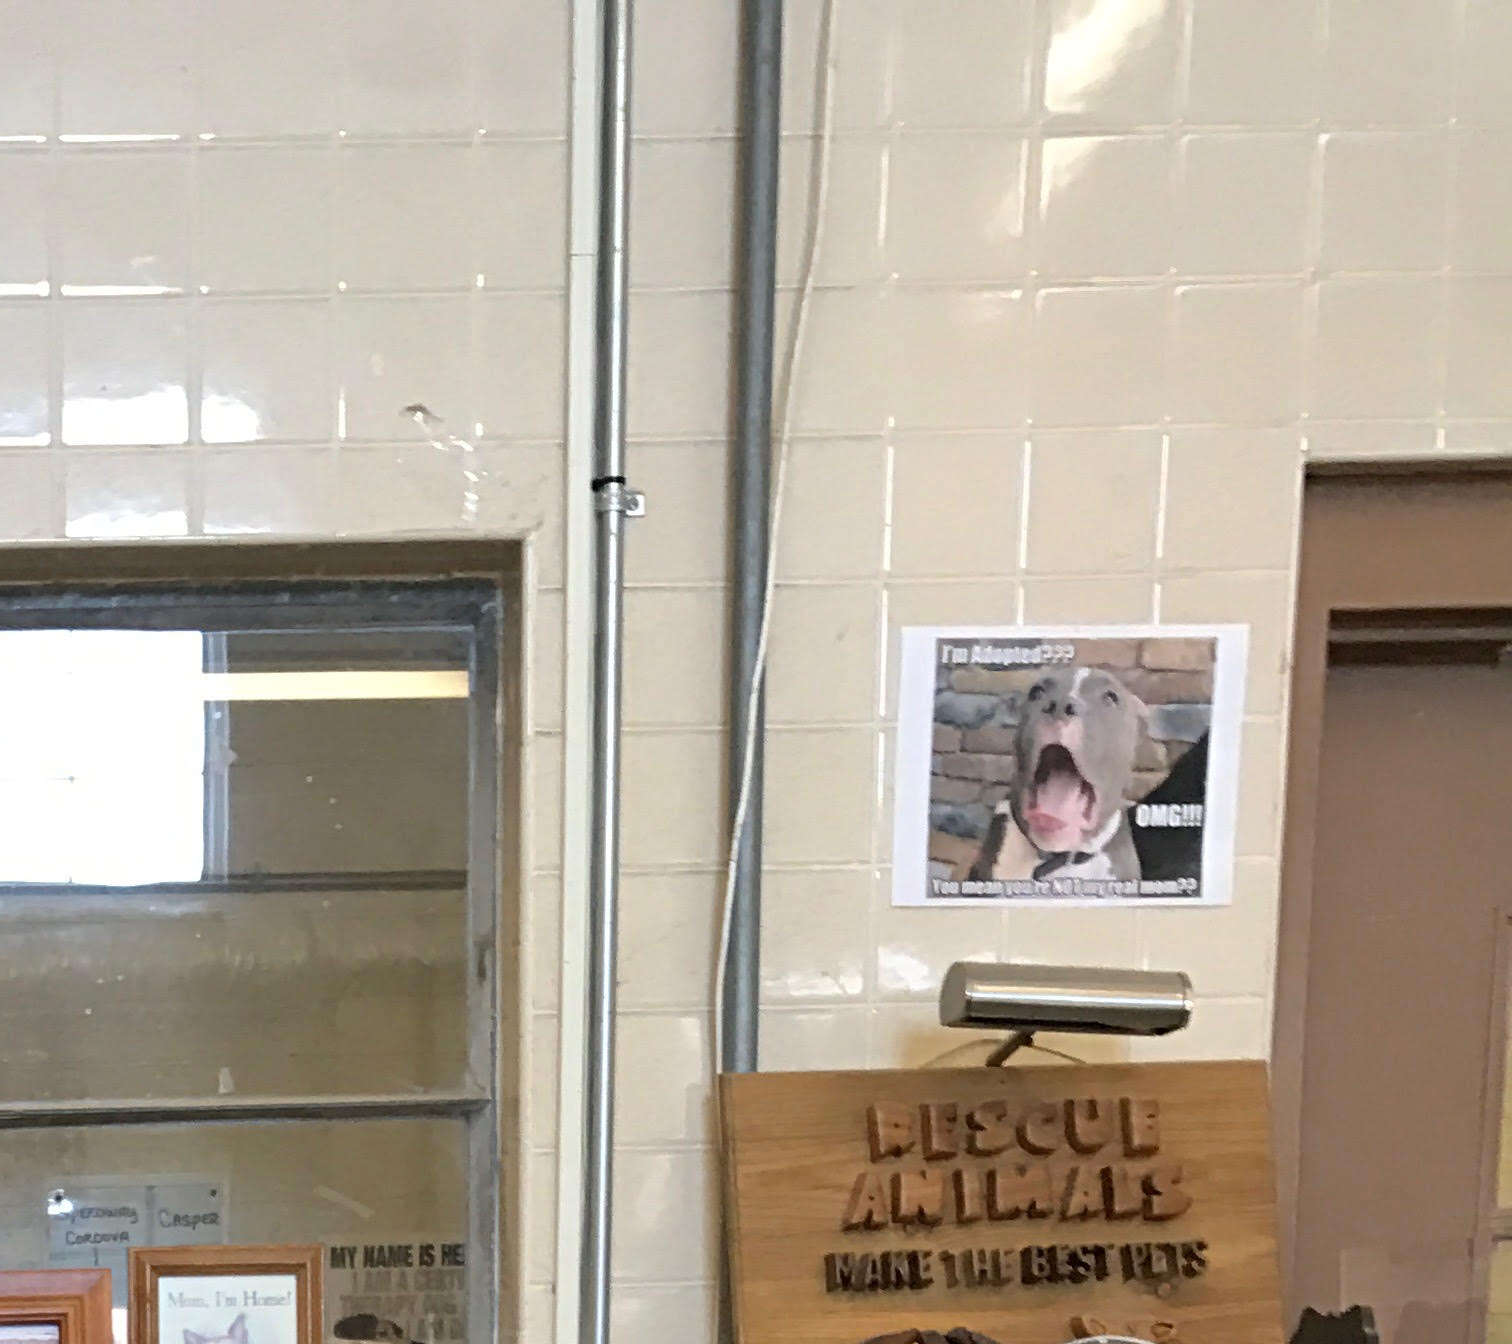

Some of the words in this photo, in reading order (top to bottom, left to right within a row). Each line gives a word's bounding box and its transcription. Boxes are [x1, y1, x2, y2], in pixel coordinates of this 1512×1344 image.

[1136, 803, 1204, 828] OMG!!!
[866, 1096, 1161, 1162] RESCUE
[841, 1164, 1193, 1231] ANIMALS
[330, 1246, 357, 1268] MY
[363, 1244, 413, 1268] NAME
[419, 1244, 435, 1267] IS
[824, 1250, 934, 1292] MAKE
[939, 1248, 1014, 1289] THE
[1020, 1244, 1113, 1285] BEST
[1120, 1240, 1208, 1283] PETS
